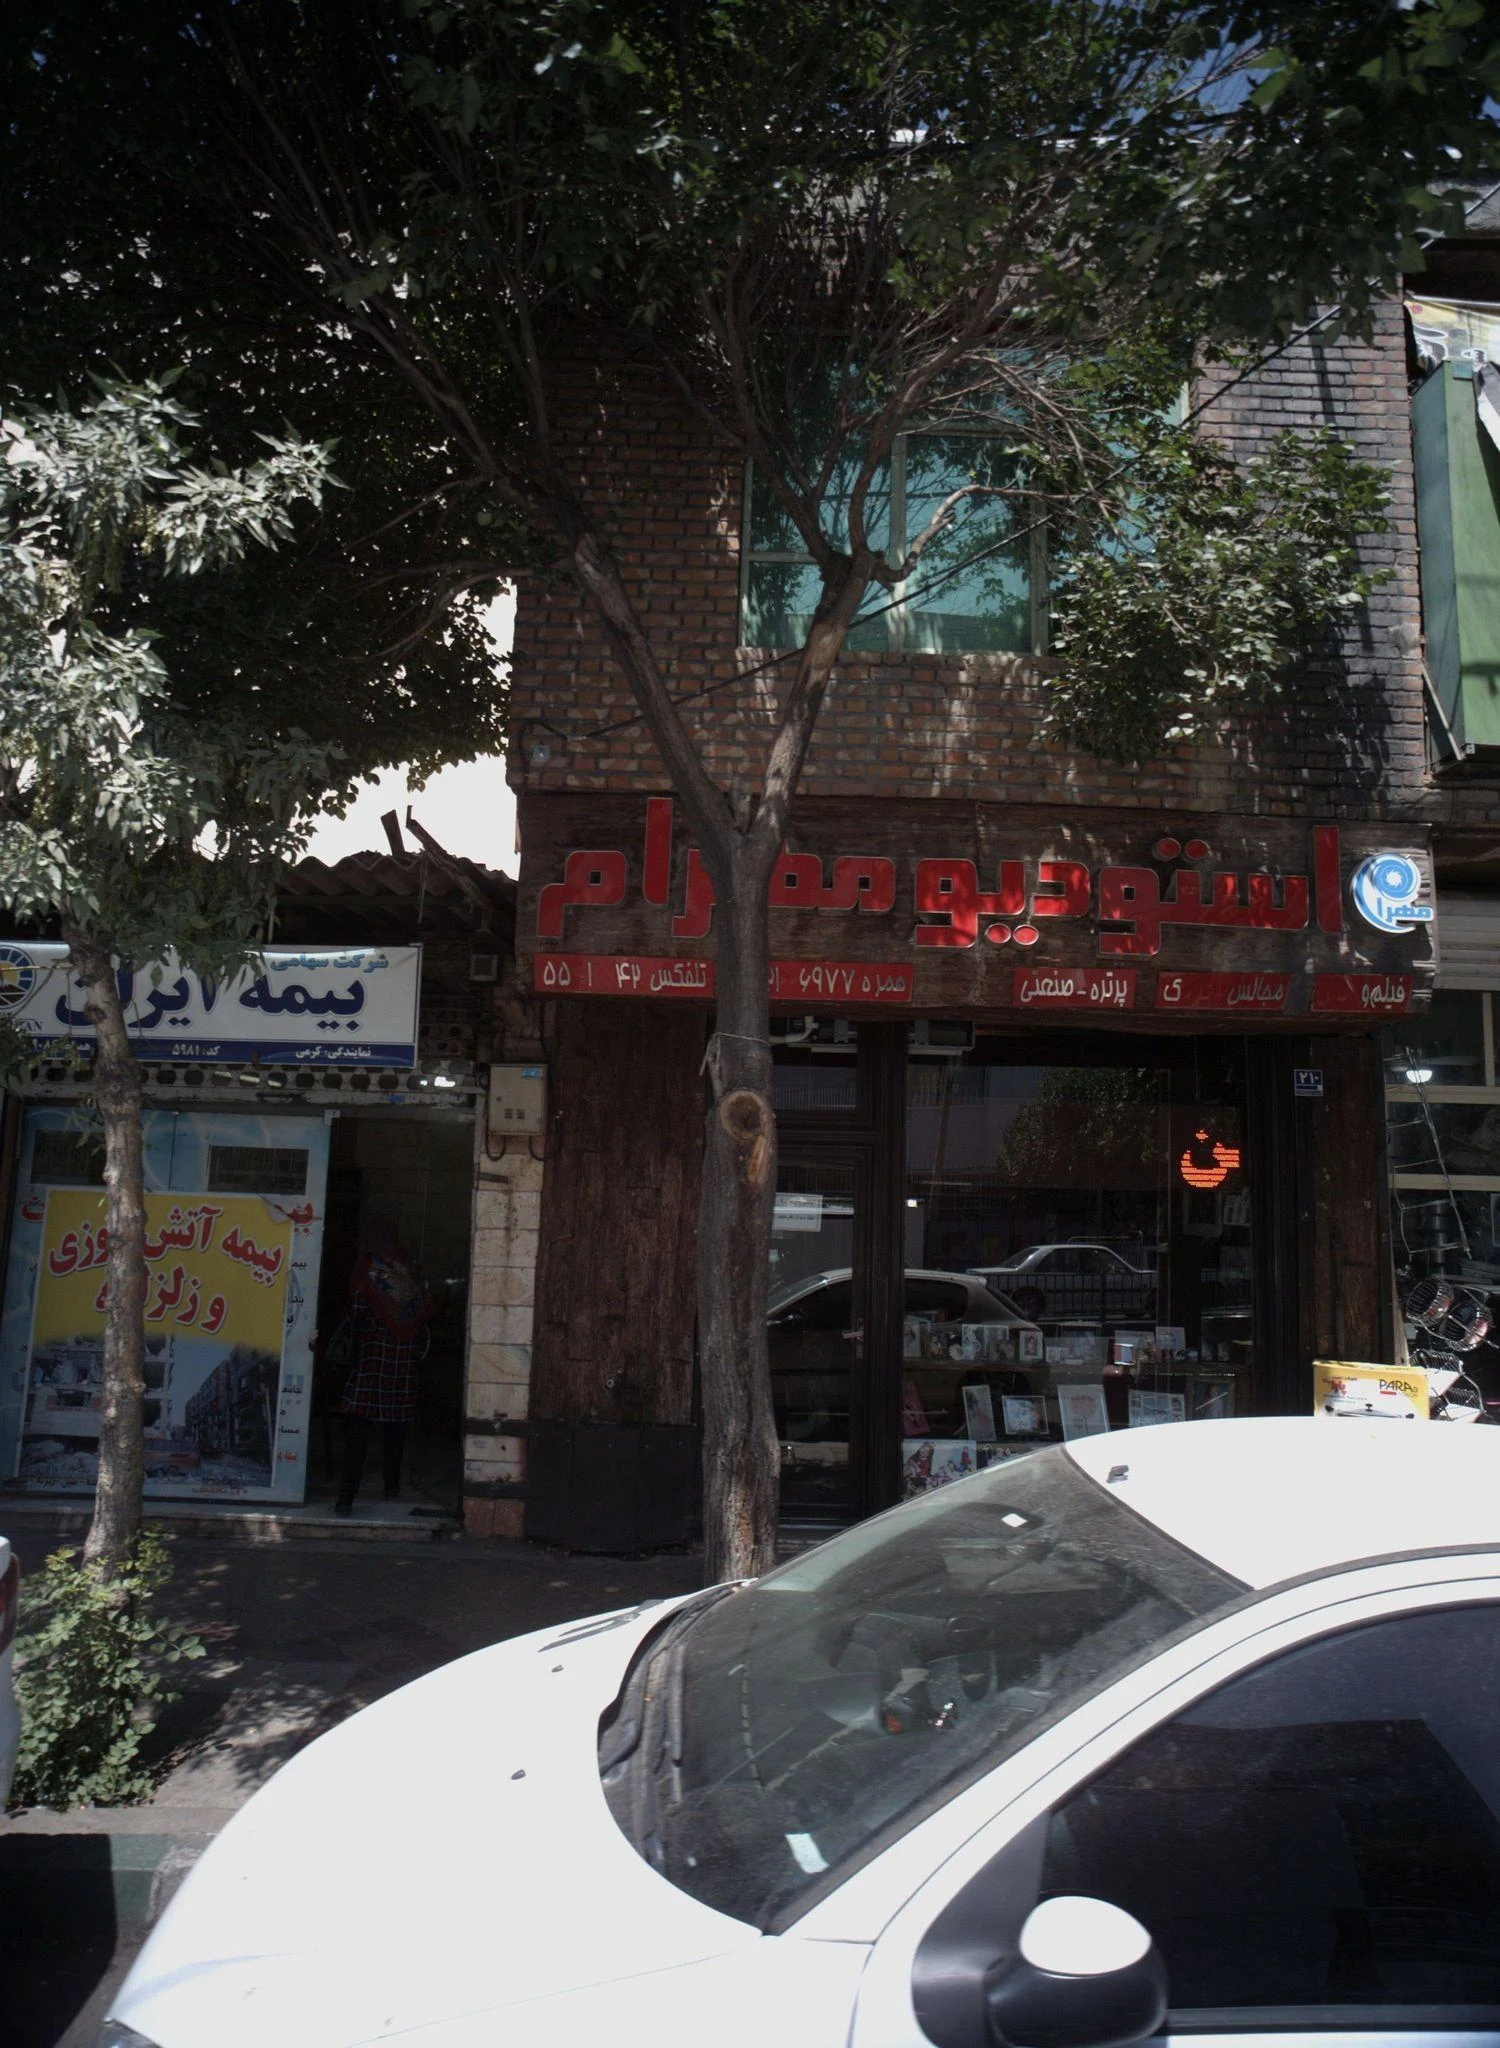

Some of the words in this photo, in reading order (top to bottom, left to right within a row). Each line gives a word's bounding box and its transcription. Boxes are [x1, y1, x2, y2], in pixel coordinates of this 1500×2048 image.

[915, 825, 1342, 956] استودیو
[271, 954, 329, 972] سهامی
[333, 953, 389, 973] شرکت
[650, 962, 707, 992] تلفکس
[239, 974, 365, 1031] بیمه
[221, 1229, 282, 1286] بیمه
